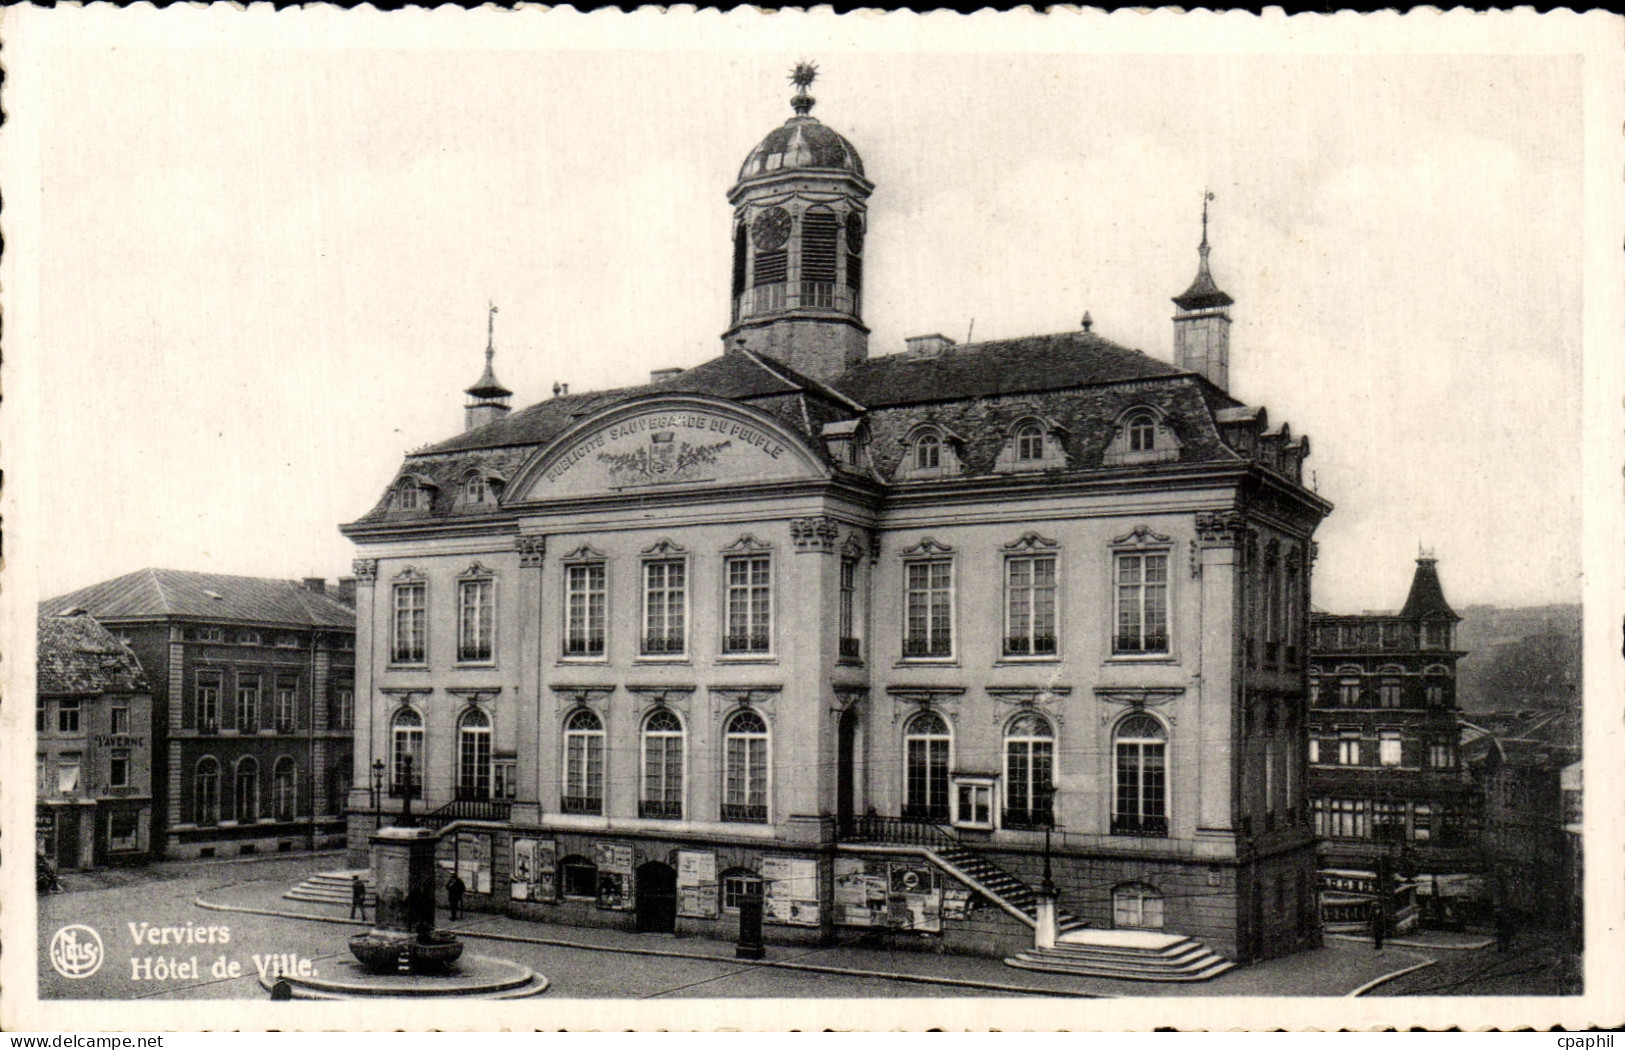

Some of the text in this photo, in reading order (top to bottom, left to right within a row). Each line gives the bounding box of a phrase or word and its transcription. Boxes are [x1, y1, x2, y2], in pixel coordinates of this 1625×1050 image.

[709, 418, 728, 433] DU
[729, 423, 784, 460] PEUPLE
[94, 733, 144, 748] TAVERNE
